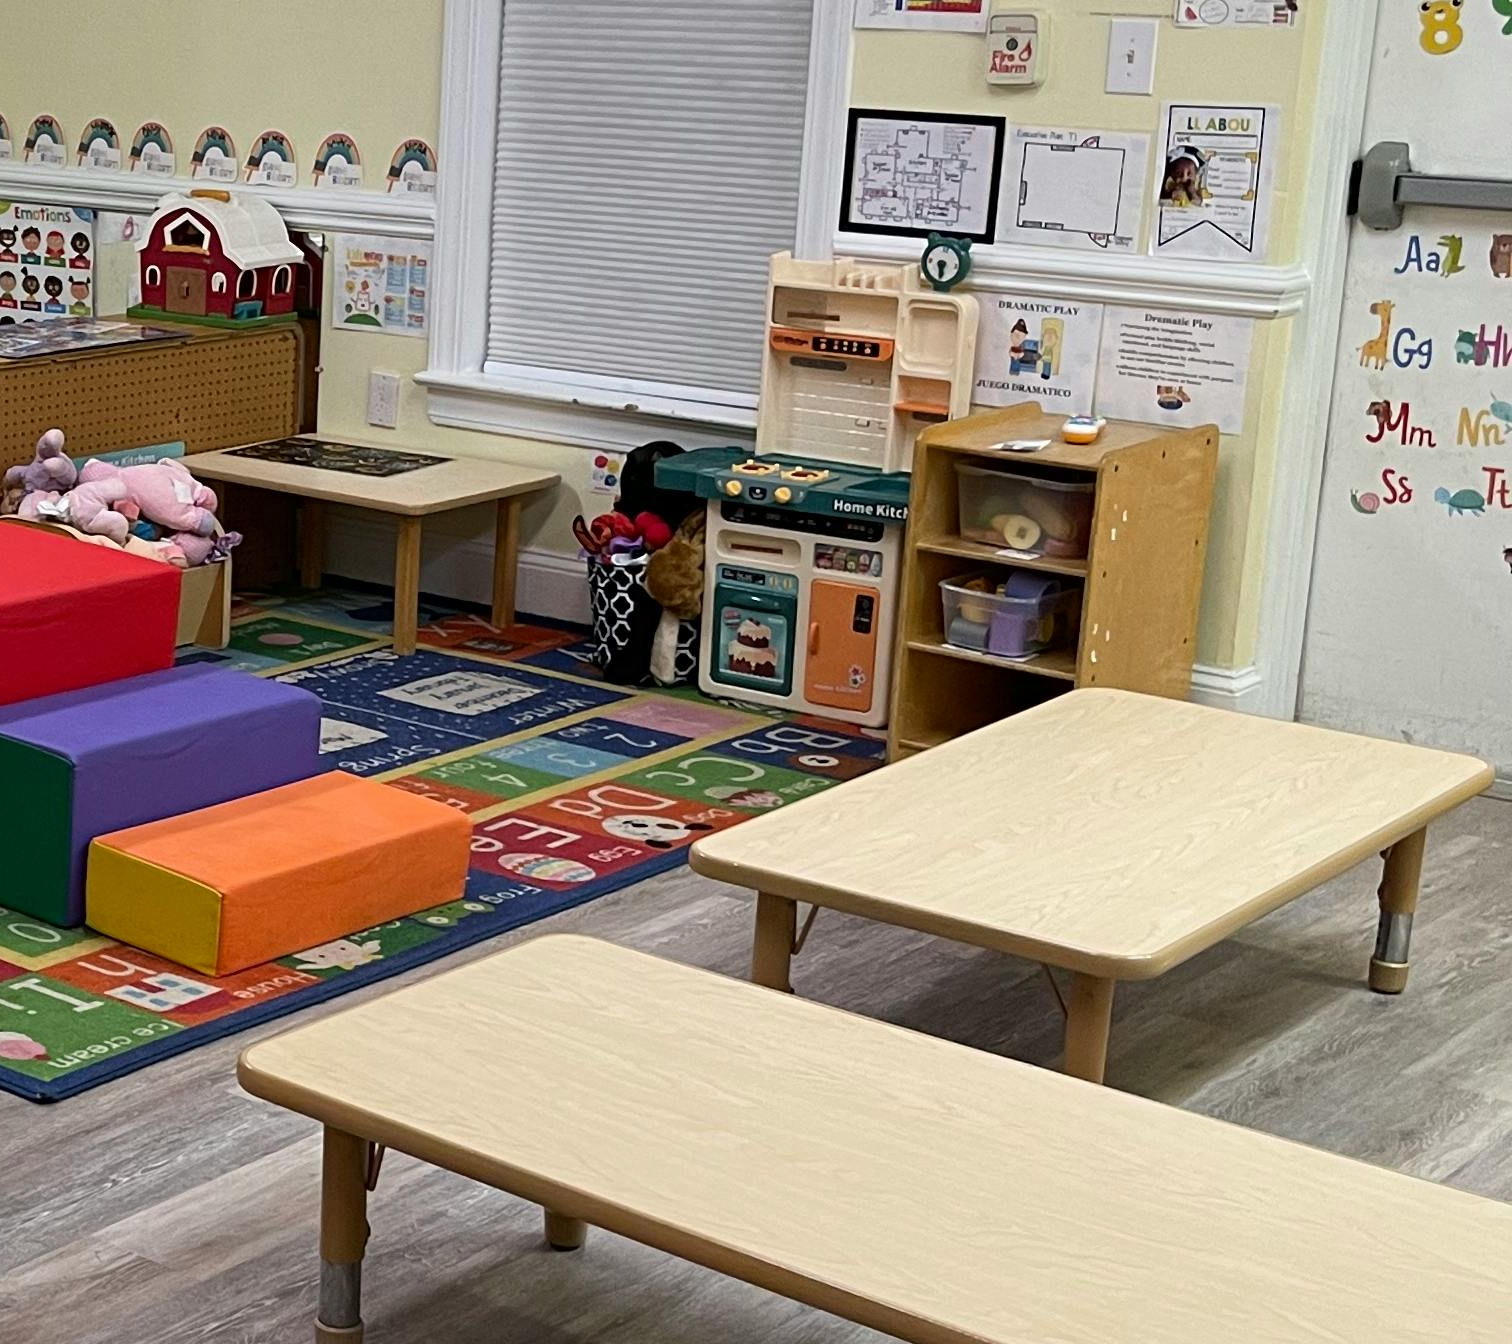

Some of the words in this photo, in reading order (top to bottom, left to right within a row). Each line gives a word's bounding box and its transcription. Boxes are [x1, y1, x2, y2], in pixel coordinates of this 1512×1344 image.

[1419, 0, 1463, 55] 8
[989, 62, 1027, 74] Alarm
[992, 50, 1016, 62] Fire
[14, 206, 71, 223] Emotions
[1394, 235, 1440, 274] Aa
[998, 300, 1052, 313] DRAMATIC
[1054, 305, 1080, 316] PLAY
[1145, 313, 1189, 326] Dramatic
[1192, 319, 1213, 330] Play
[1392, 328, 1432, 369] Gg
[976, 379, 1009, 390] JUEGO
[1011, 383, 1071, 398] DRAMATICO
[1366, 402, 1436, 447] Mm
[1456, 407, 1506, 448] Nn
[1382, 468, 1413, 504] Ss
[834, 499, 873, 515] Home
[512, 697, 598, 725] Winter
[732, 727, 852, 754] Bb
[338, 744, 441, 772] Spring
[646, 756, 765, 786] Cc
[550, 785, 677, 819] Dd
[587, 844, 642, 863] Egg
[478, 883, 543, 906] Frog
[233, 970, 318, 999] House
[48, 1036, 133, 1068] cream
